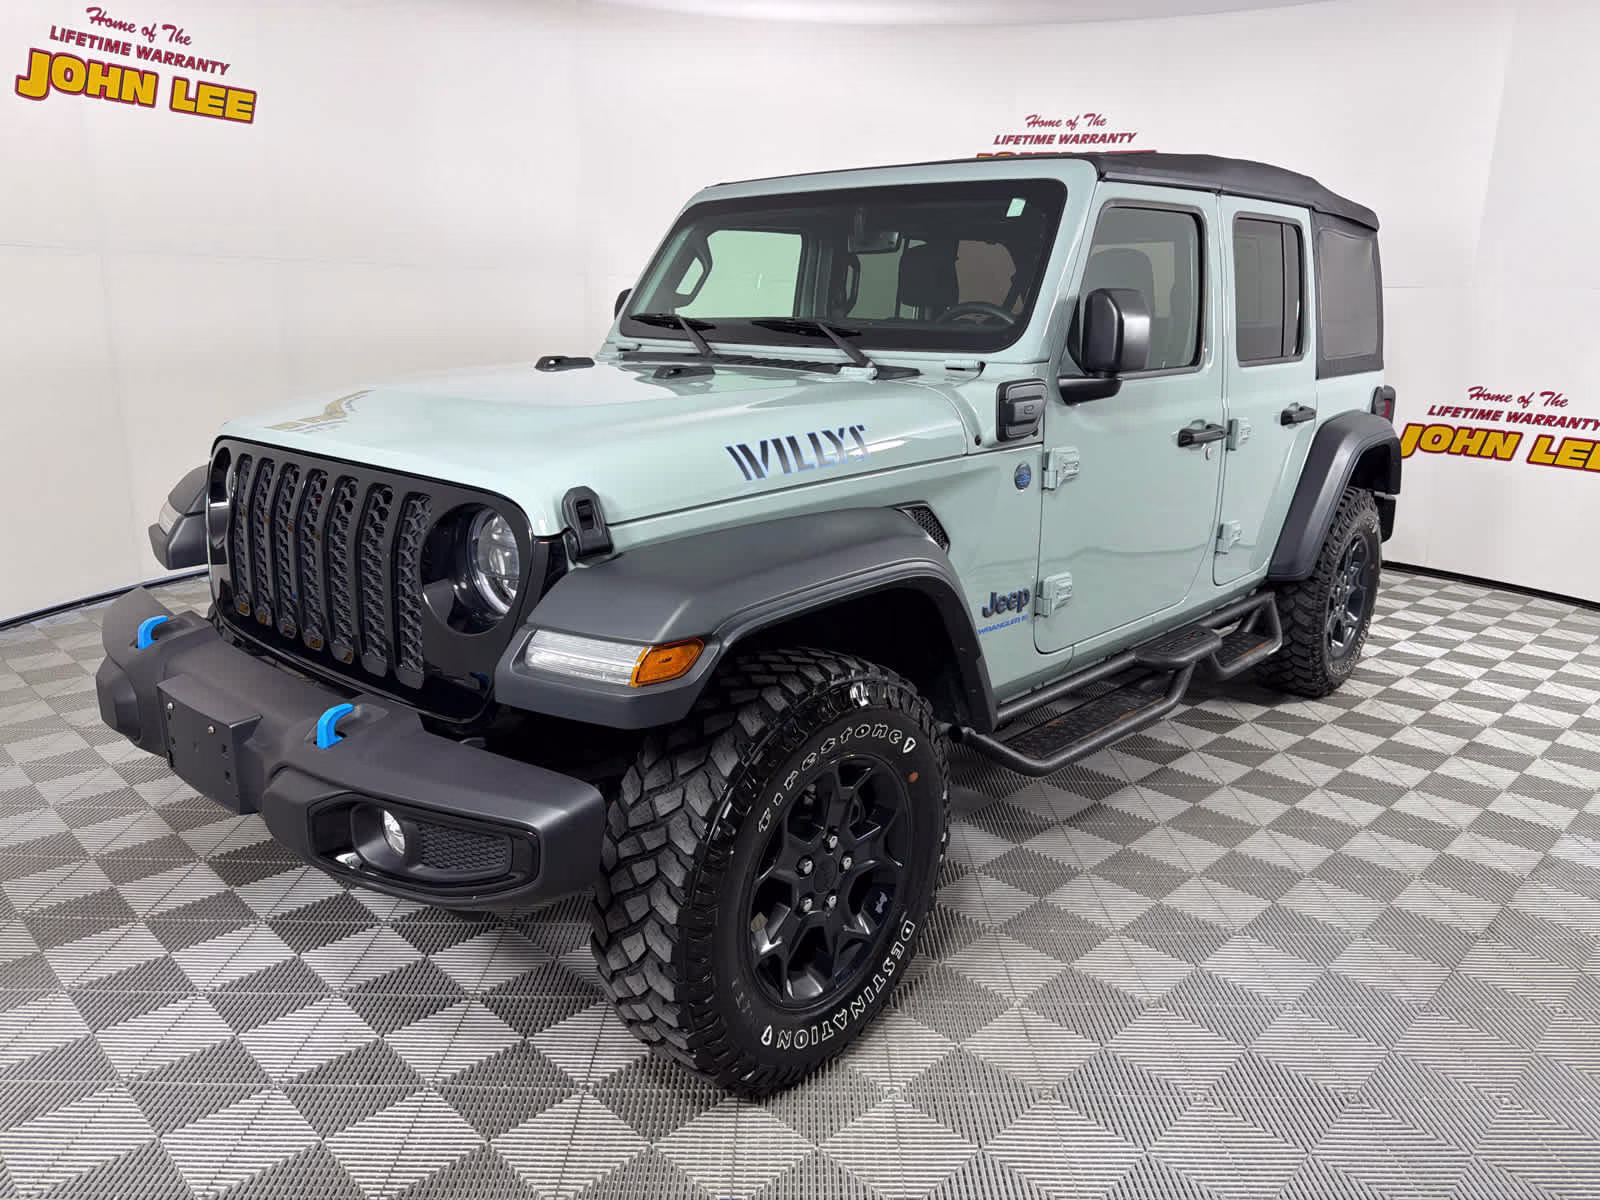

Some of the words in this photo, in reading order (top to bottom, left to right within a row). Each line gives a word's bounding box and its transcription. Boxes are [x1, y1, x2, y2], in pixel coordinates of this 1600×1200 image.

[86, 7, 136, 34] Home
[141, 24, 157, 43] of
[162, 24, 192, 46] The
[50, 25, 132, 56] LIFETIME
[136, 44, 231, 76] WARRANTY
[15, 48, 160, 109] JOHN
[169, 76, 257, 125] LEE
[993, 134, 1056, 145] LIFETIME
[1058, 132, 1137, 145] WARRANTY
[1024, 114, 1063, 128] Home
[1065, 115, 1080, 131] of
[1083, 113, 1107, 127] The
[1467, 386, 1513, 404] Home
[1516, 391, 1535, 409] of
[1539, 391, 1569, 408] The
[1427, 405, 1504, 423] LIFETIME
[1506, 411, 1600, 432] WARRANTY
[725, 425, 868, 481] WILLYS
[1401, 423, 1523, 461] JOHN
[982, 588, 1030, 618] Jeep
[776, 920, 915, 1049] DESTINATION
